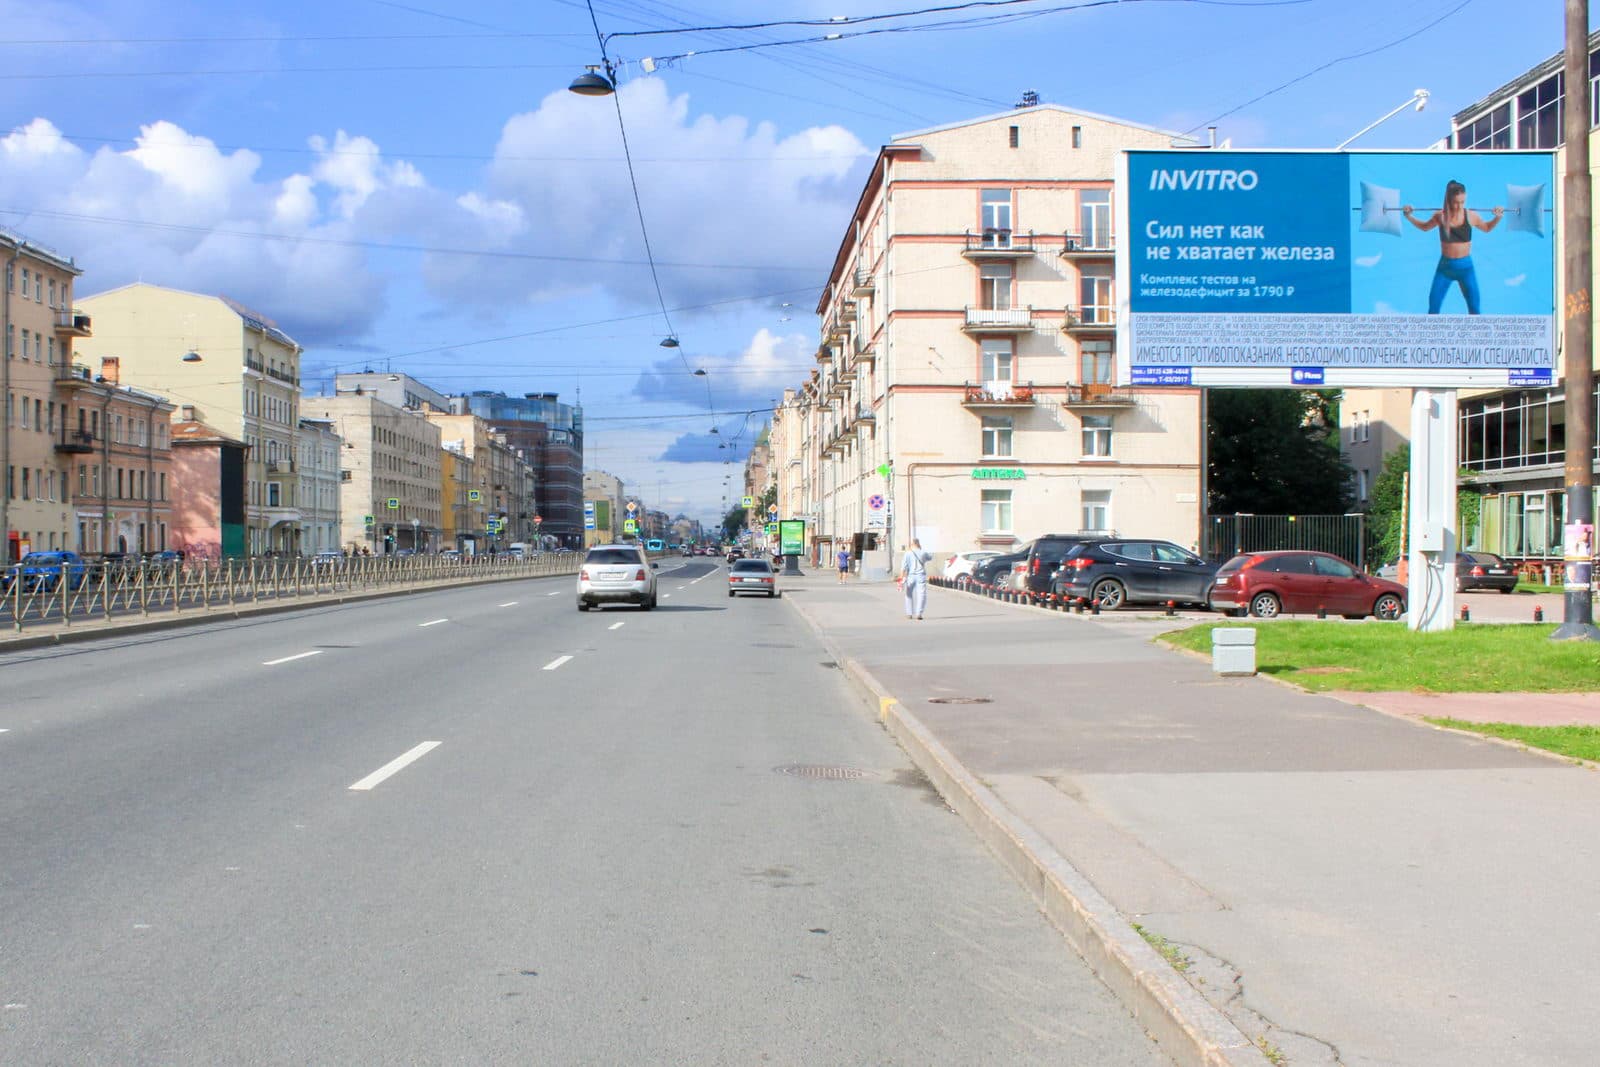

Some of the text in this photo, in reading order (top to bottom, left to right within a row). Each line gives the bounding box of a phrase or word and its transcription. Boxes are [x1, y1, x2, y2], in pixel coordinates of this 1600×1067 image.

[1149, 169, 1258, 191] INVITRO
[1146, 220, 1264, 239] Сил нет как
[1146, 246, 1335, 260] не хватает железа
[1140, 273, 1256, 285] Комплекс тестов на
[1140, 286, 1234, 298] железодефицит
[1237, 288, 1250, 297] за
[1254, 286, 1284, 297] 1790
[1136, 346, 1551, 366] ИМЕЮТСЯ ПРОТИВОПОКАЗАНИЯ. НЕОБХОДИМО ПОЛУЧЕНИЕ КОНСУЛЬТАЦИИ СПЕЦИАЛИСТА.
[971, 467, 1027, 481] АПТЕКА
